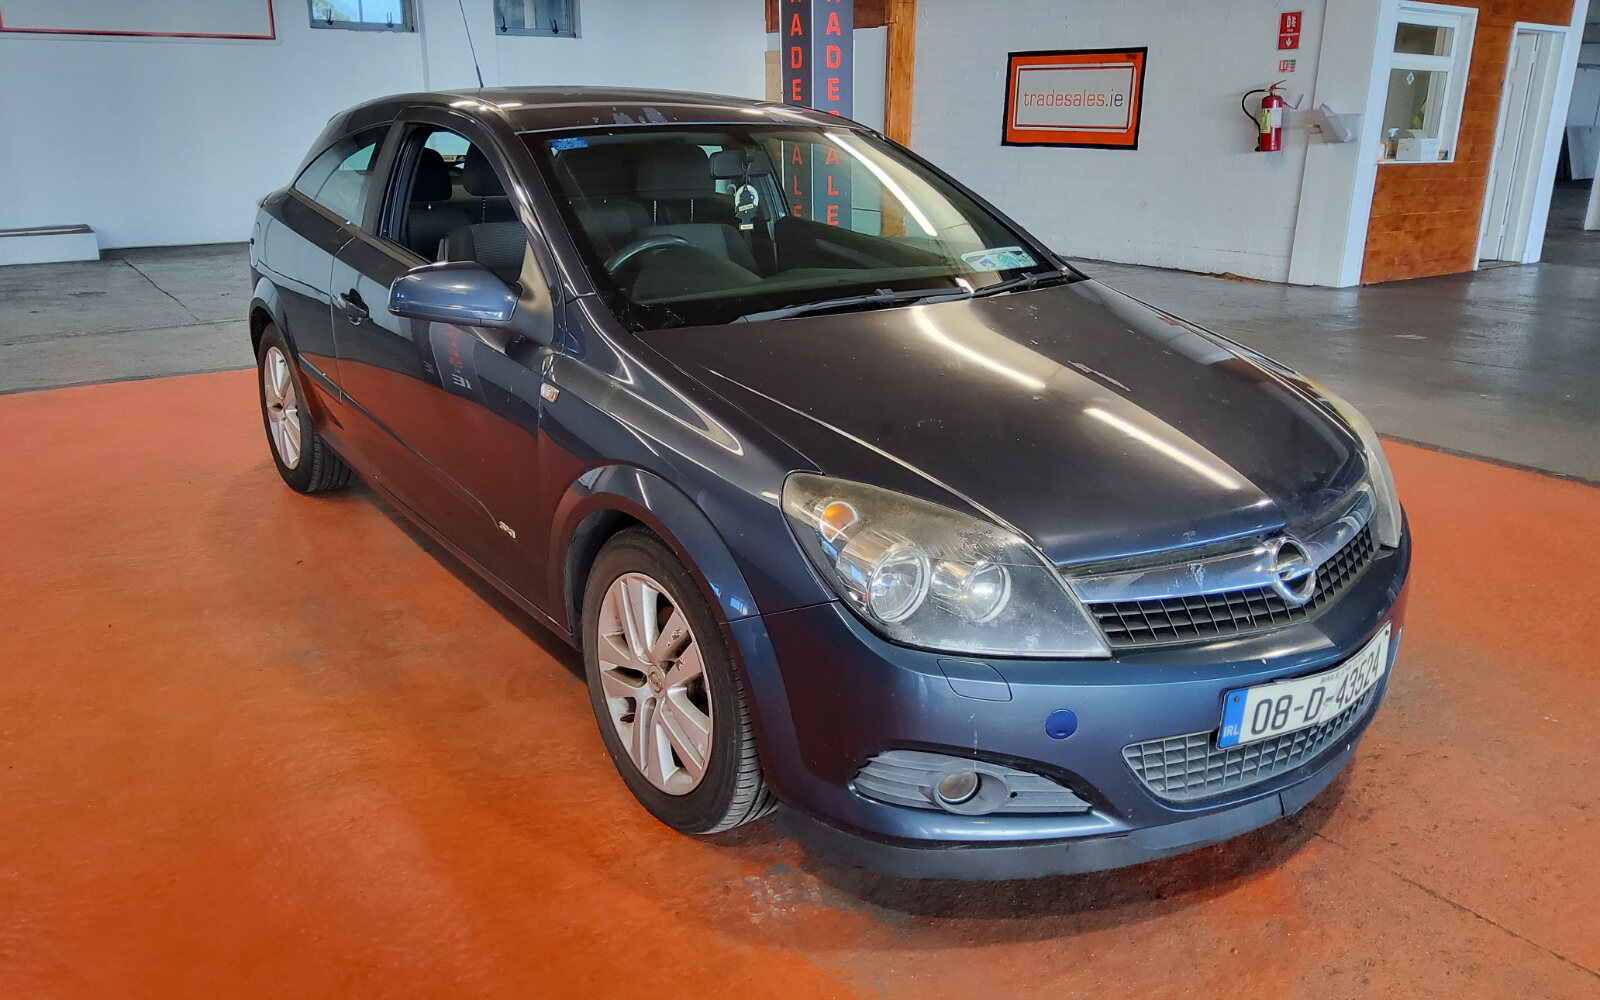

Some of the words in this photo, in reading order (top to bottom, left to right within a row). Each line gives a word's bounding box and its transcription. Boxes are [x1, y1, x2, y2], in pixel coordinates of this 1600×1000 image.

[1023, 88, 1124, 107] tradesales.ie
[1251, 643, 1382, 735] 08-D-43524
[1223, 723, 1240, 738] IRL
